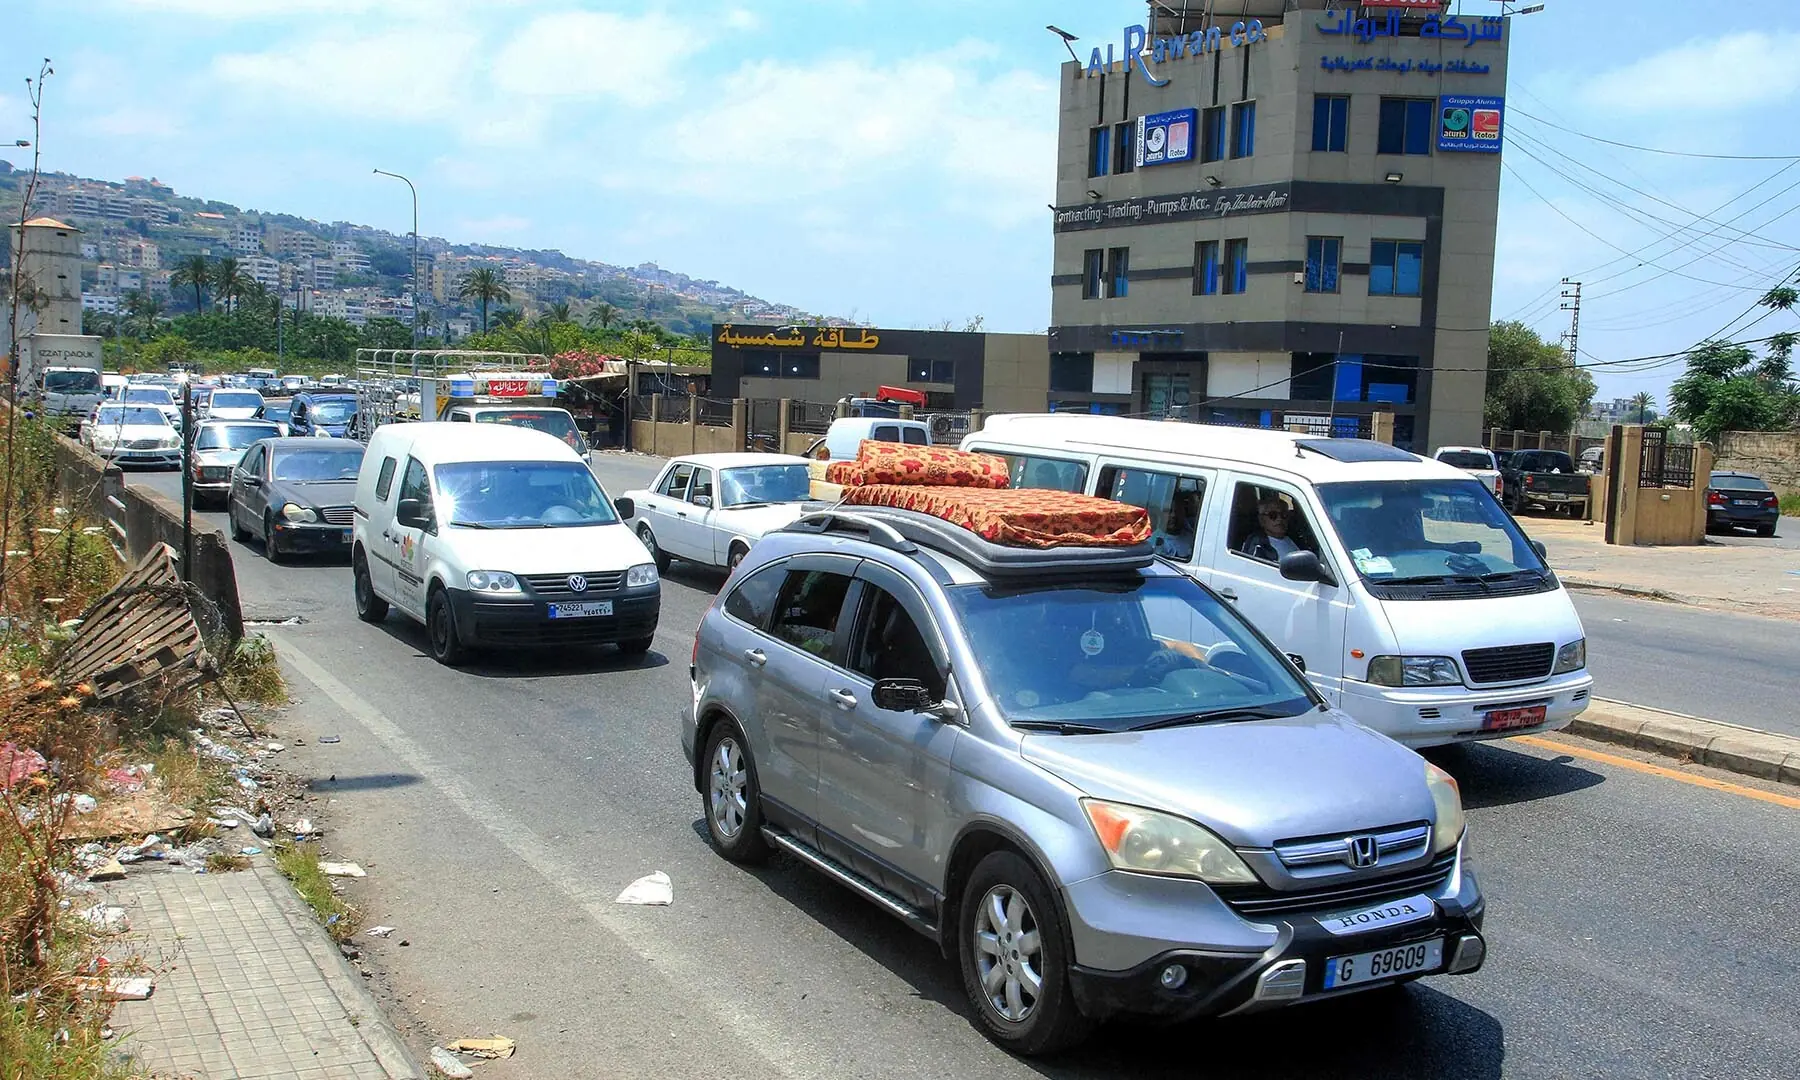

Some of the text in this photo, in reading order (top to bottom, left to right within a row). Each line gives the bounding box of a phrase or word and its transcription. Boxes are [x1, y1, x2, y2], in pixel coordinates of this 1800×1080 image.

[1315, 8, 1504, 49] شركة الروان
[1124, 24, 1222, 88] Rawan
[1444, 59, 1490, 74] مضخات
[1448, 97, 1475, 105] Gruppo
[717, 323, 879, 349] طاقة شمسية
[1338, 903, 1419, 928] HONDA
[1340, 944, 1426, 982] G 69609
